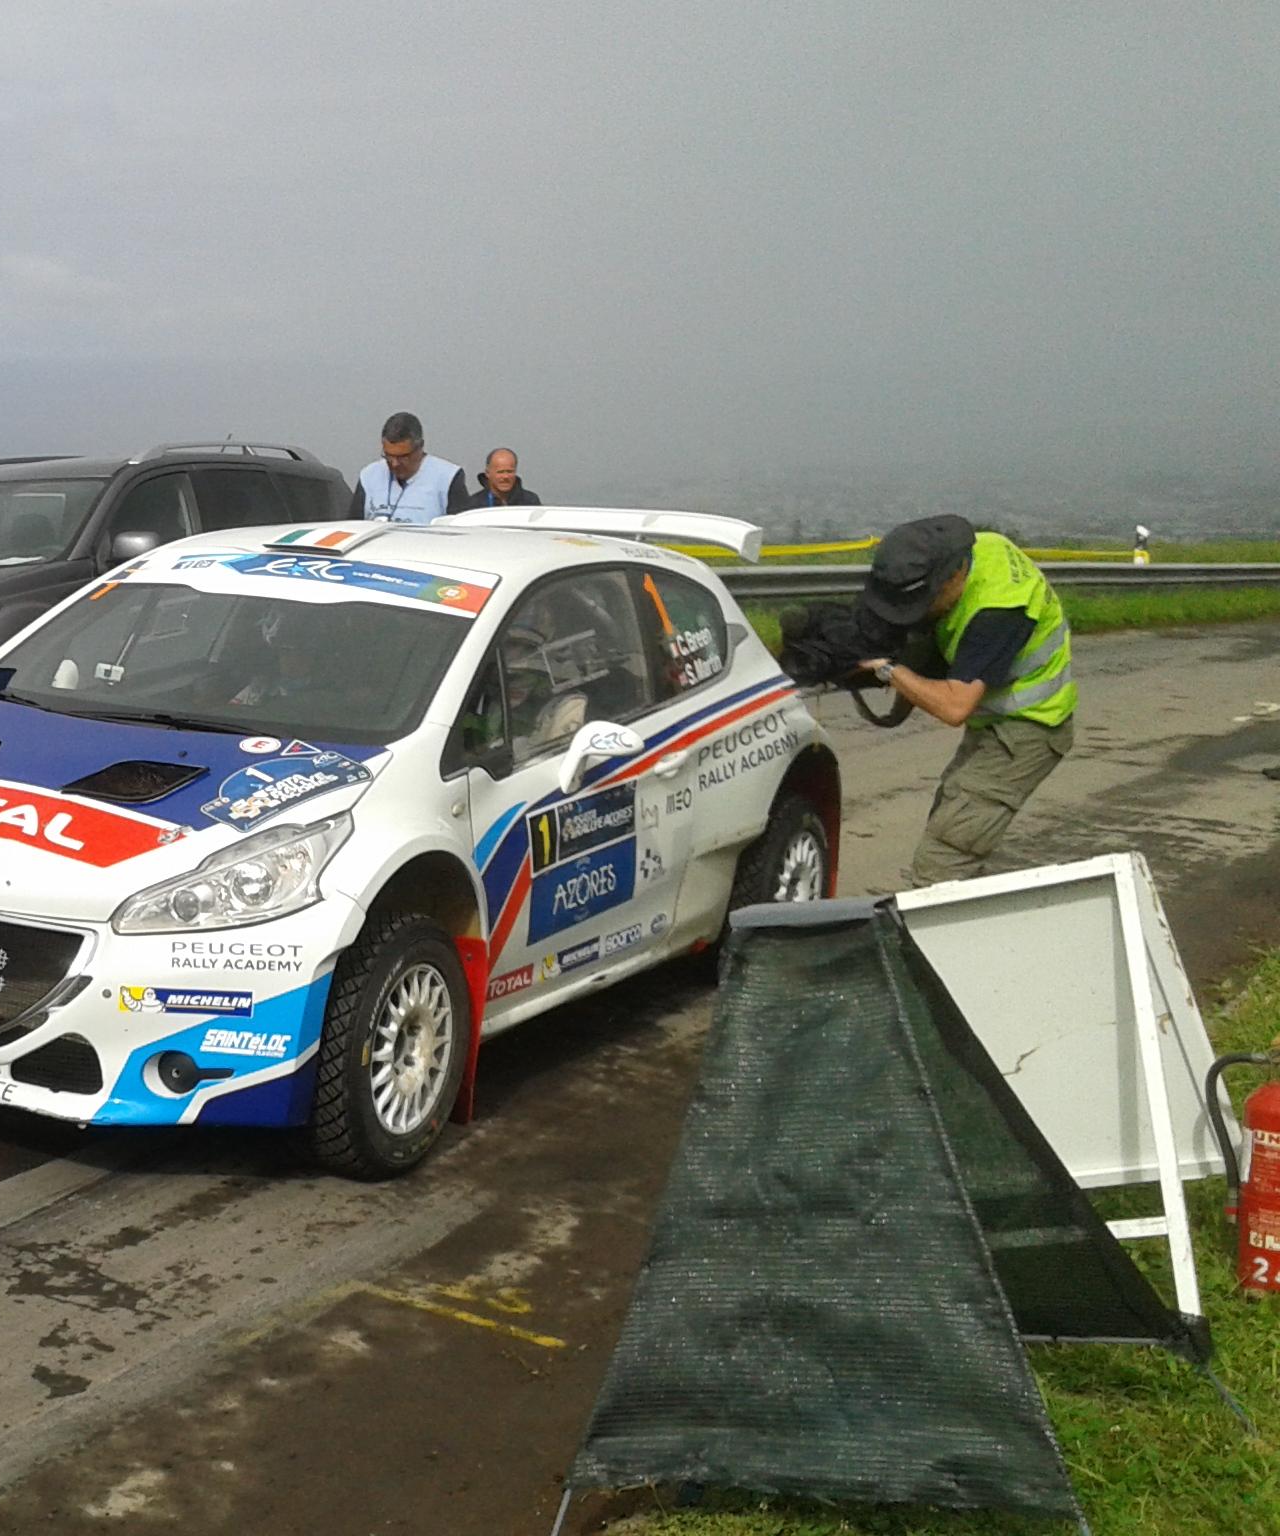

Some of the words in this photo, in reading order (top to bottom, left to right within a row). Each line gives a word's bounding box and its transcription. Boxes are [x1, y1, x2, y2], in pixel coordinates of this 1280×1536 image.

[698, 708, 788, 766] PEUGEOT
[699, 760, 737, 791] RALLY
[740, 731, 800, 773] ACADEMY
[538, 813, 551, 866] 1
[553, 863, 616, 915] AZORES
[171, 941, 303, 958] PEUGEOT
[171, 957, 219, 969] RALLY
[223, 959, 303, 972] ACADEMY
[167, 994, 252, 1009] MICHELIN
[489, 973, 532, 996] TOTAL
